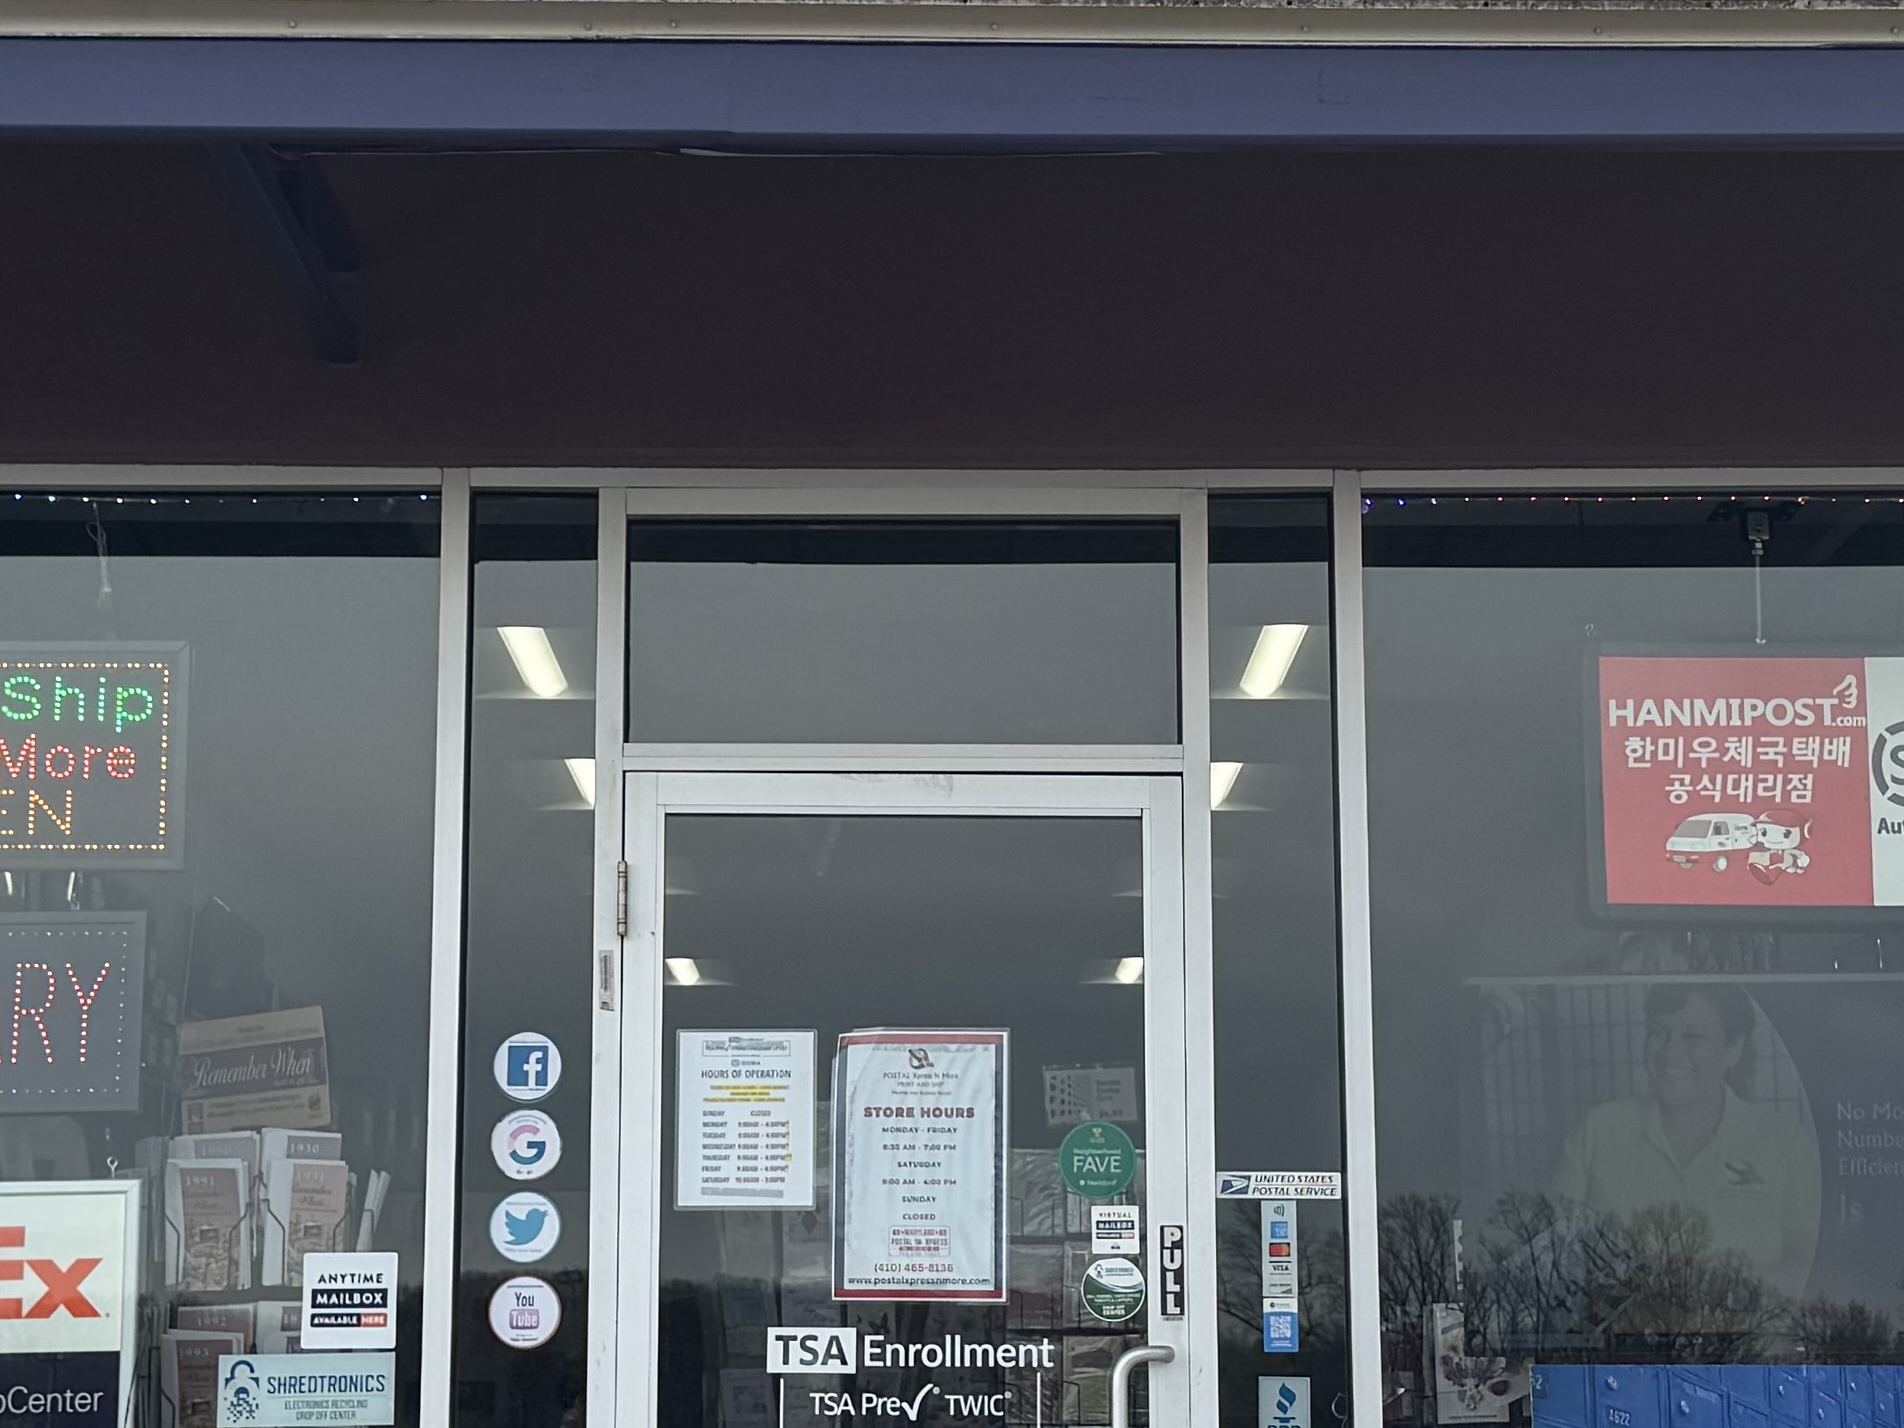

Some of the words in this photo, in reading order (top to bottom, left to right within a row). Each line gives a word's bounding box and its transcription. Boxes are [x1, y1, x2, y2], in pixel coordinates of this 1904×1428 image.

[1, 676, 154, 732] Ship
[1624, 735, 1851, 769] 한미우체국택배
[1664, 774, 1814, 804] 공식대리점
[864, 1107, 915, 1118] STORE
[920, 1107, 975, 1118] HOURS
[1073, 1156, 1122, 1173] FAVE
[1254, 1175, 1295, 1184] UNITED
[1297, 1175, 1334, 1184] STATES
[1252, 1186, 1292, 1196] POSTAL
[1294, 1187, 1337, 1196] SERVICE
[318, 1273, 384, 1284] ANYTIME
[1162, 1226, 1182, 1315] PULL
[316, 1293, 383, 1305] MAILBOX
[774, 1334, 849, 1366] TSA
[864, 1334, 1056, 1369] Enrollment
[267, 1374, 385, 1394] SHREDTRONICS
[810, 1393, 854, 1416] TSA
[945, 1394, 1004, 1417] TWIC
